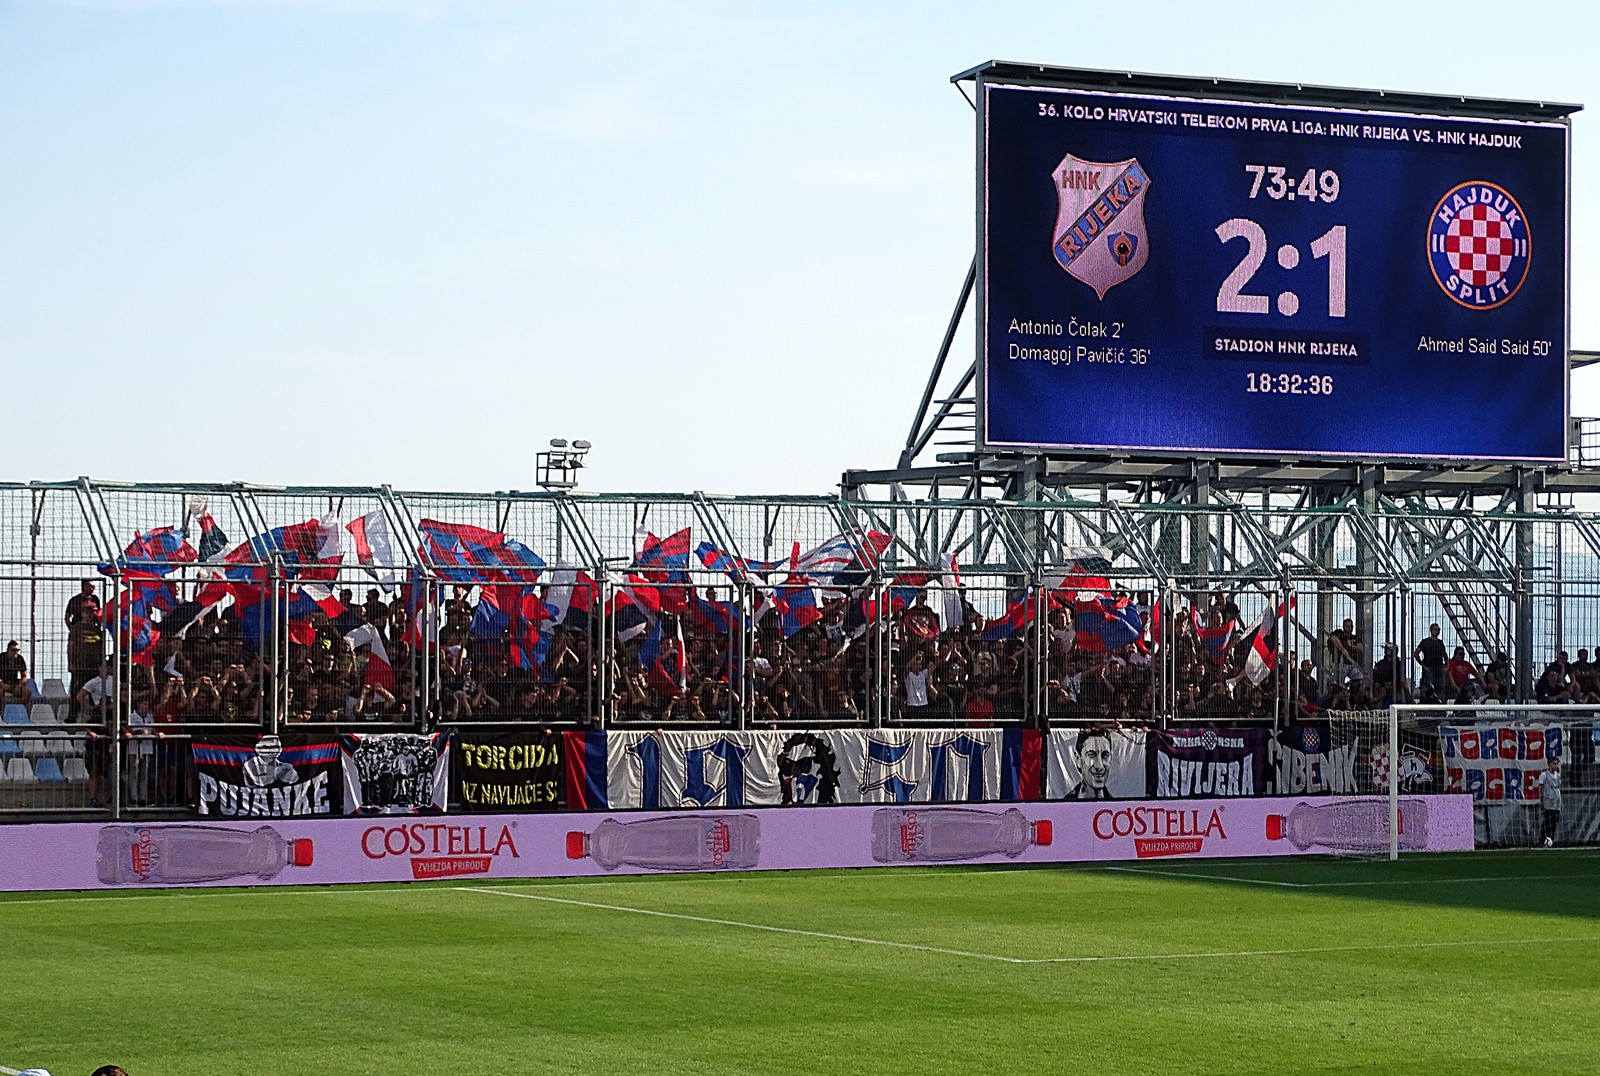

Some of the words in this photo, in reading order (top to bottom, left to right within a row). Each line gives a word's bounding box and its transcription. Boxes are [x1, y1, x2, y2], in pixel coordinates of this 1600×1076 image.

[1038, 103, 1059, 117] 36.
[1064, 105, 1104, 119] KOLO
[1108, 108, 1177, 125] HRVATSKI
[1181, 112, 1248, 130] TELEKOM
[1252, 118, 1289, 132] PRVA
[1292, 120, 1327, 136] LIGA:
[1330, 124, 1359, 138] HNK
[1363, 126, 1410, 141] RIJEKA
[1413, 129, 1434, 143] VS.
[1437, 131, 1466, 145] HNK
[1469, 133, 1523, 149] HAJDUK
[1061, 170, 1101, 190] HNK
[1245, 164, 1340, 203] 73:49
[1060, 175, 1142, 258] RIJEKA
[1438, 187, 1521, 229] HAJDUK
[1214, 217, 1347, 318] 2:1
[1446, 274, 1510, 304] SPLIT
[1008, 317, 1063, 336] Antonio
[1068, 316, 1107, 338] Čolak
[1112, 322, 1125, 338] 2'
[1009, 343, 1071, 365] Domagoj
[1076, 346, 1125, 364] Pavičić
[1130, 348, 1151, 365] 36'
[1215, 338, 1274, 353] STADION
[1278, 340, 1306, 354] HNK
[1310, 343, 1358, 357] RIJEKA
[1417, 335, 1464, 353] Ahmed
[1468, 337, 1497, 354] Said
[1501, 339, 1529, 356] Said
[1533, 340, 1552, 356] 50'
[1246, 372, 1333, 395] 18:32:36
[461, 743, 559, 770] TORCIDA
[1440, 727, 1562, 760] TORCIDA
[1156, 749, 1255, 797] RIVIJERA
[1446, 767, 1560, 801] ZAGRE
[198, 770, 331, 817] PUJANKE
[1140, 842, 1170, 852] ZVIJEZDA
[1170, 841, 1198, 851] PRIRODE
[417, 862, 452, 872] ZVIJEZDA
[452, 860, 485, 871] PRIRODE
